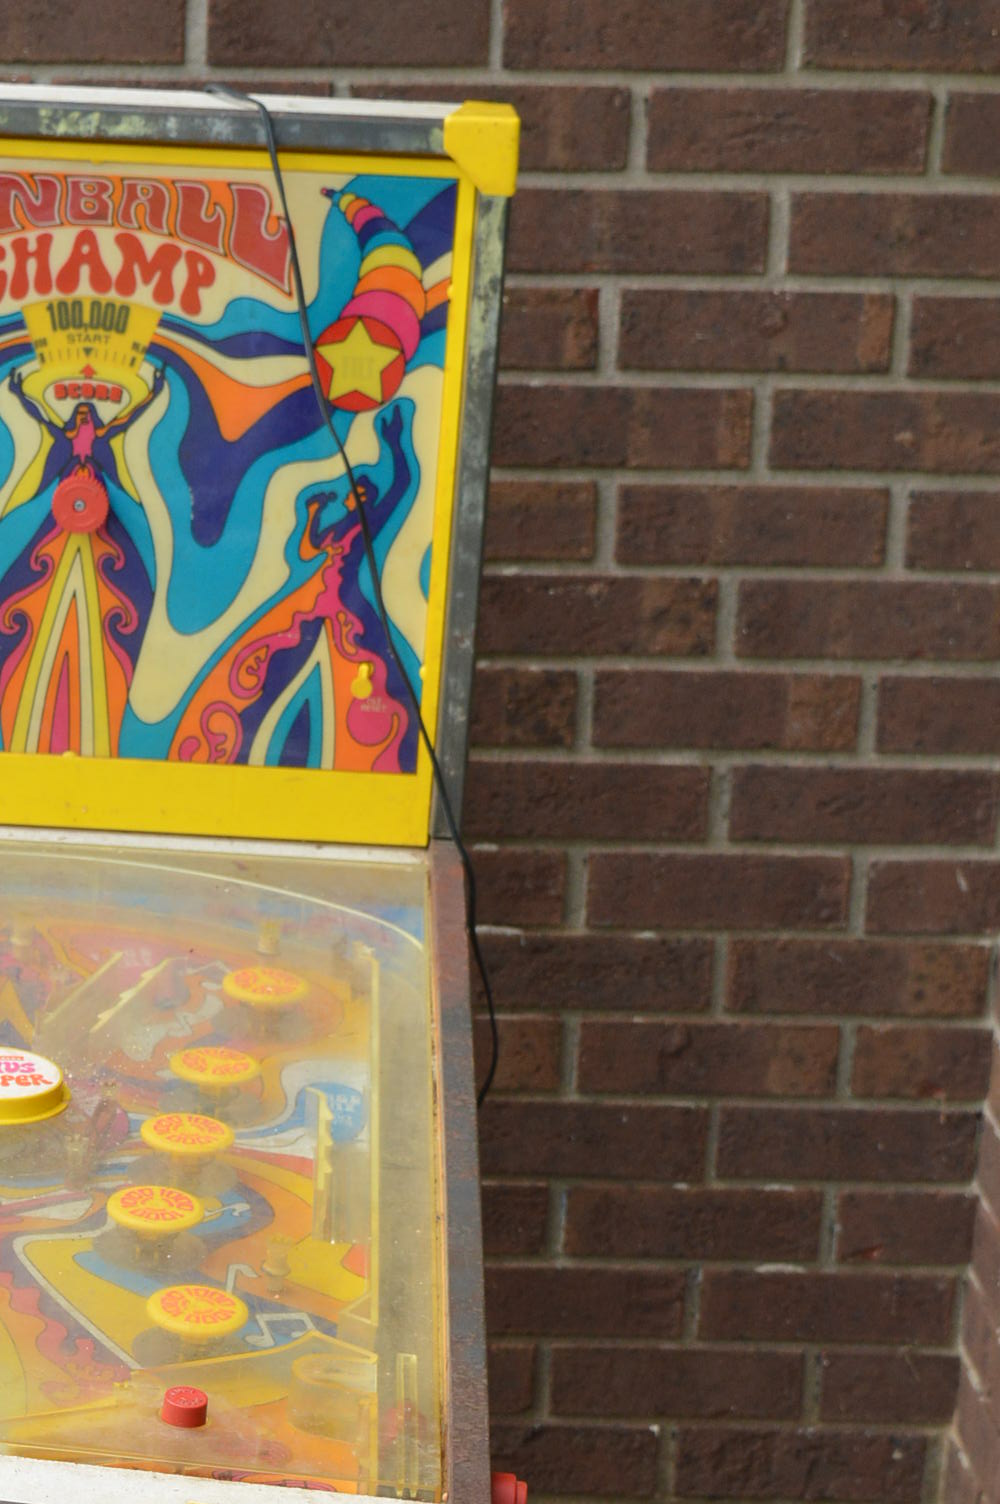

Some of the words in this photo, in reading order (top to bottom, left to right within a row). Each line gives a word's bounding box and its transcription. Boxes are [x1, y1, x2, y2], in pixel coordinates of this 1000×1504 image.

[47, 300, 131, 334] 100,000
[66, 333, 112, 345] START
[53, 382, 124, 404] SCORE
